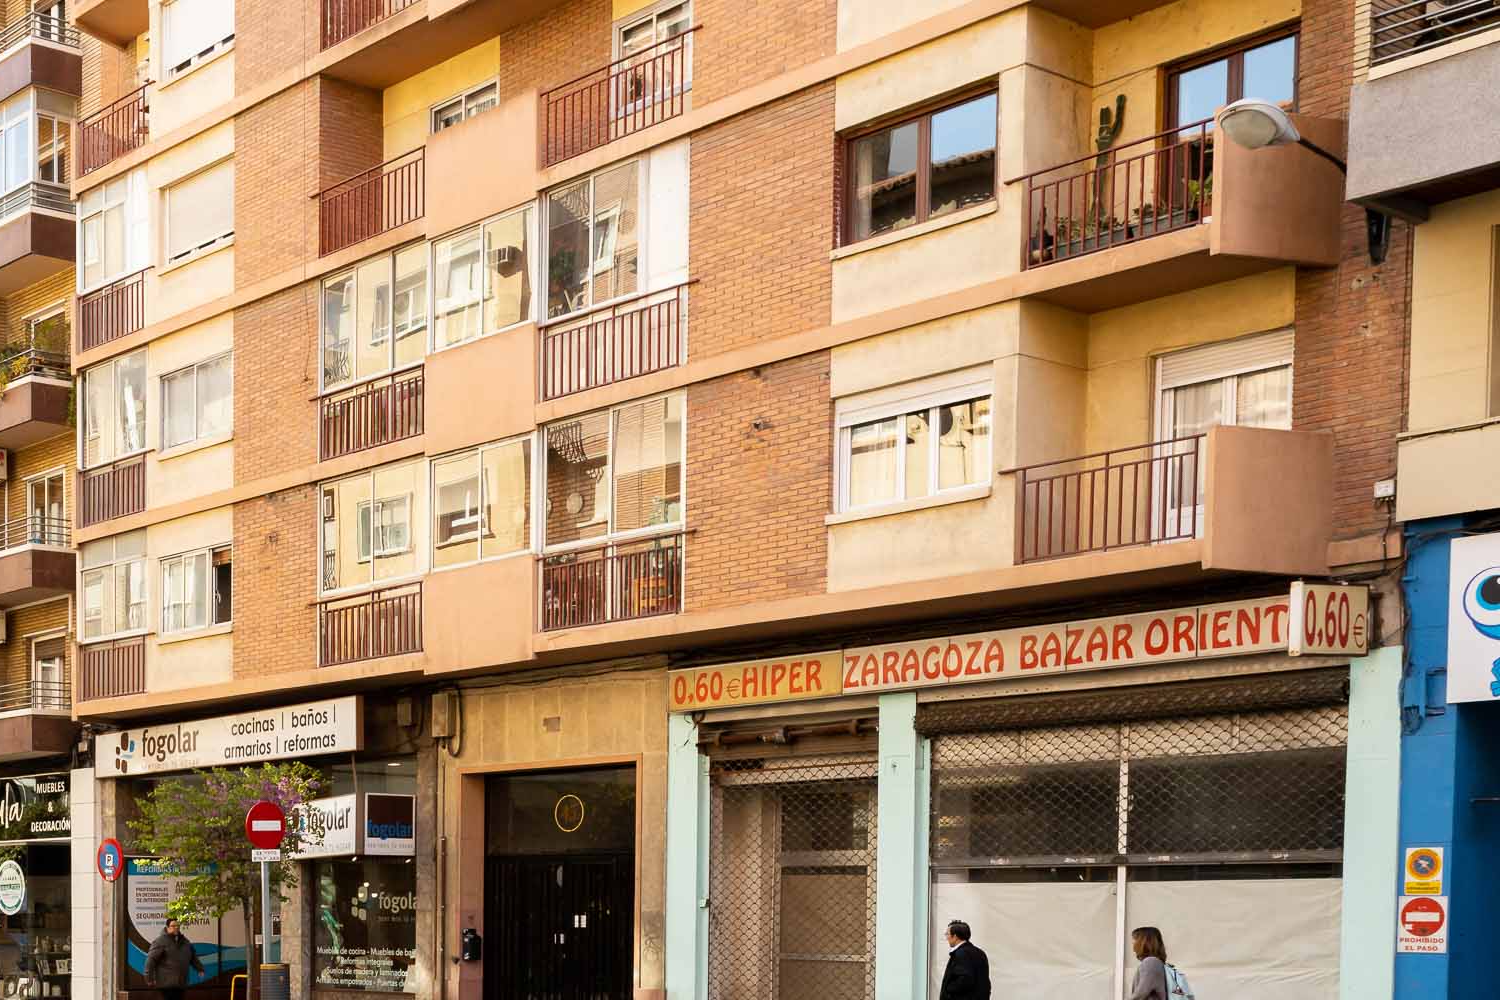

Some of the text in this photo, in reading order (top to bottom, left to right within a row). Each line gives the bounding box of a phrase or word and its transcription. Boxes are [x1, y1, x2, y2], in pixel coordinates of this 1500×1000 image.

[741, 660, 822, 698] HIPER
[843, 638, 1004, 688] ZARAGOZA
[1019, 623, 1134, 669] BAZAR
[1144, 604, 1290, 656] ORIENT
[142, 725, 199, 762] fogolar
[231, 718, 275, 736] cocinas
[292, 708, 328, 728] baños
[224, 740, 271, 759] armarios
[284, 733, 336, 753] reformas
[36, 781, 65, 794] MUEBLES
[47, 801, 53, 812] &
[31, 817, 71, 832] DECORACIÓN
[307, 802, 350, 838] fogolar
[367, 819, 413, 840] fogolar
[379, 891, 417, 913] fogola
